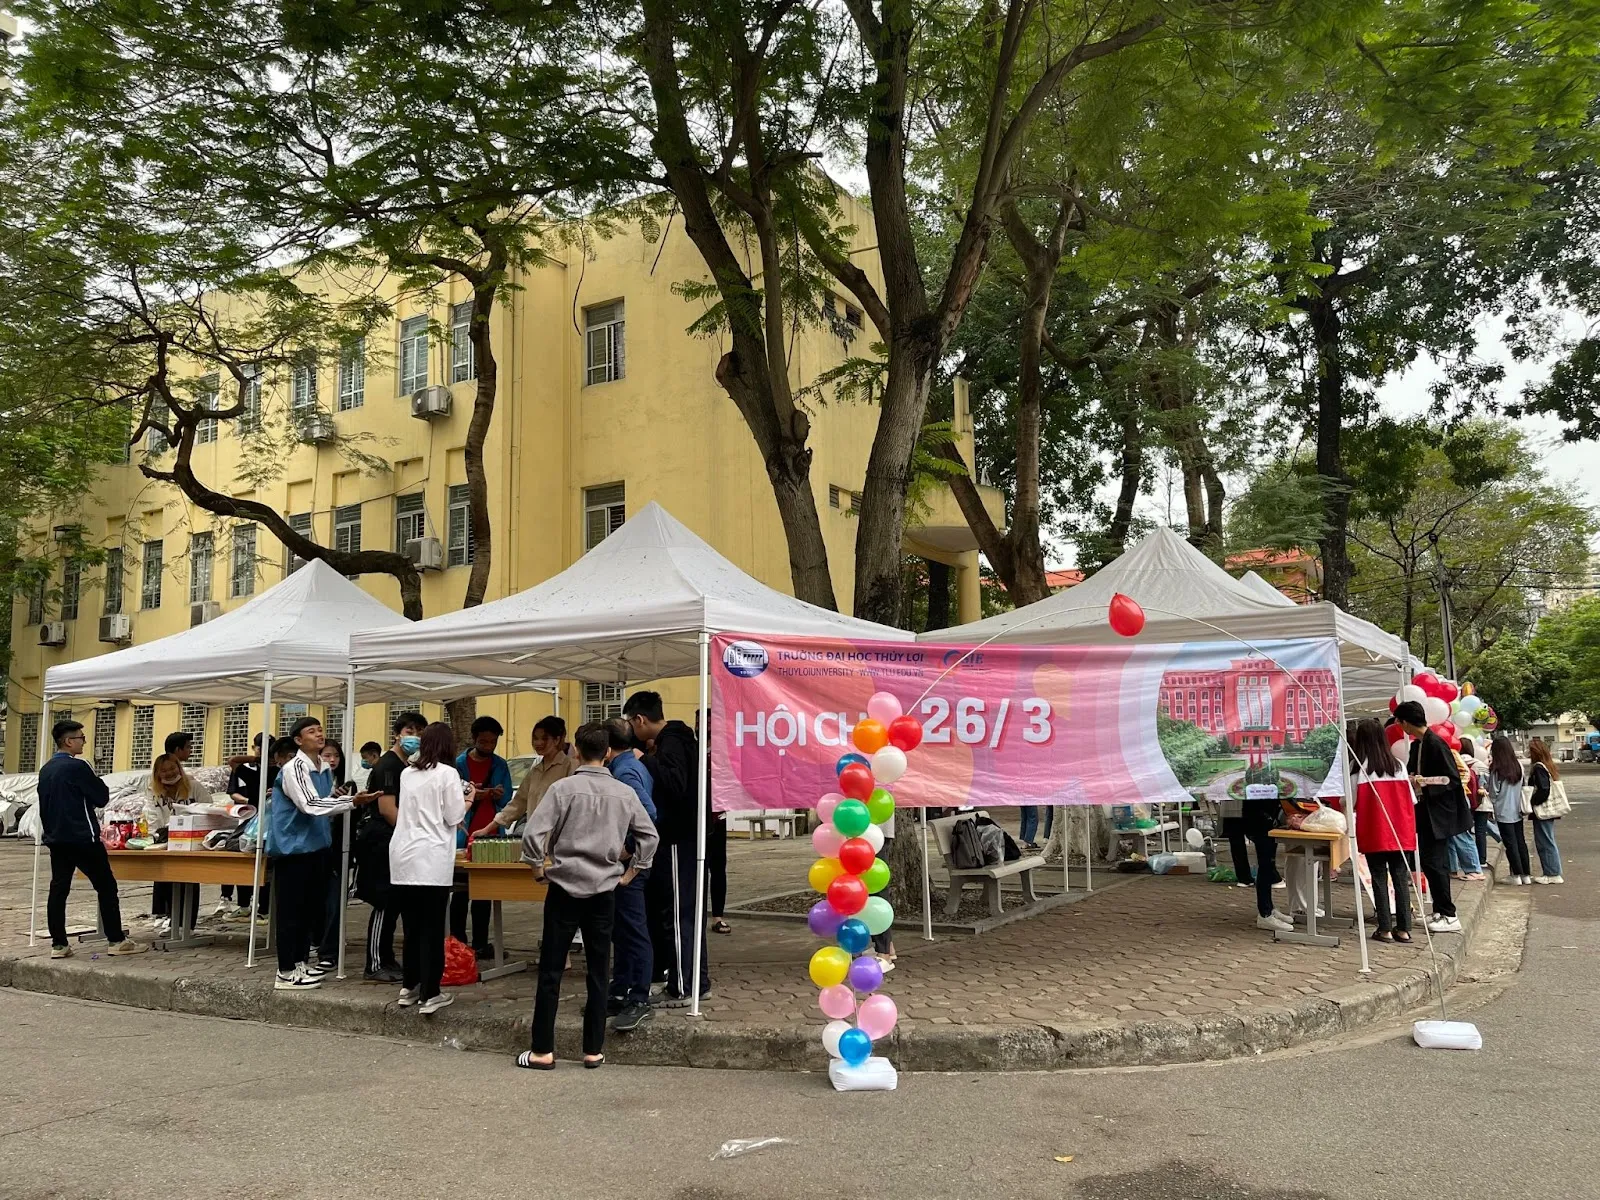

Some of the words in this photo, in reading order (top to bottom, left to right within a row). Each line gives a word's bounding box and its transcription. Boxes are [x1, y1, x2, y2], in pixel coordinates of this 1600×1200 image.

[777, 649, 823, 661] TRƯỜNG
[875, 650, 904, 662] THỦY
[907, 653, 924, 665] LỢI
[778, 667, 854, 677] THUYLOIUNIVERSITY
[735, 703, 807, 756] HỘI
[813, 711, 868, 747] CH
